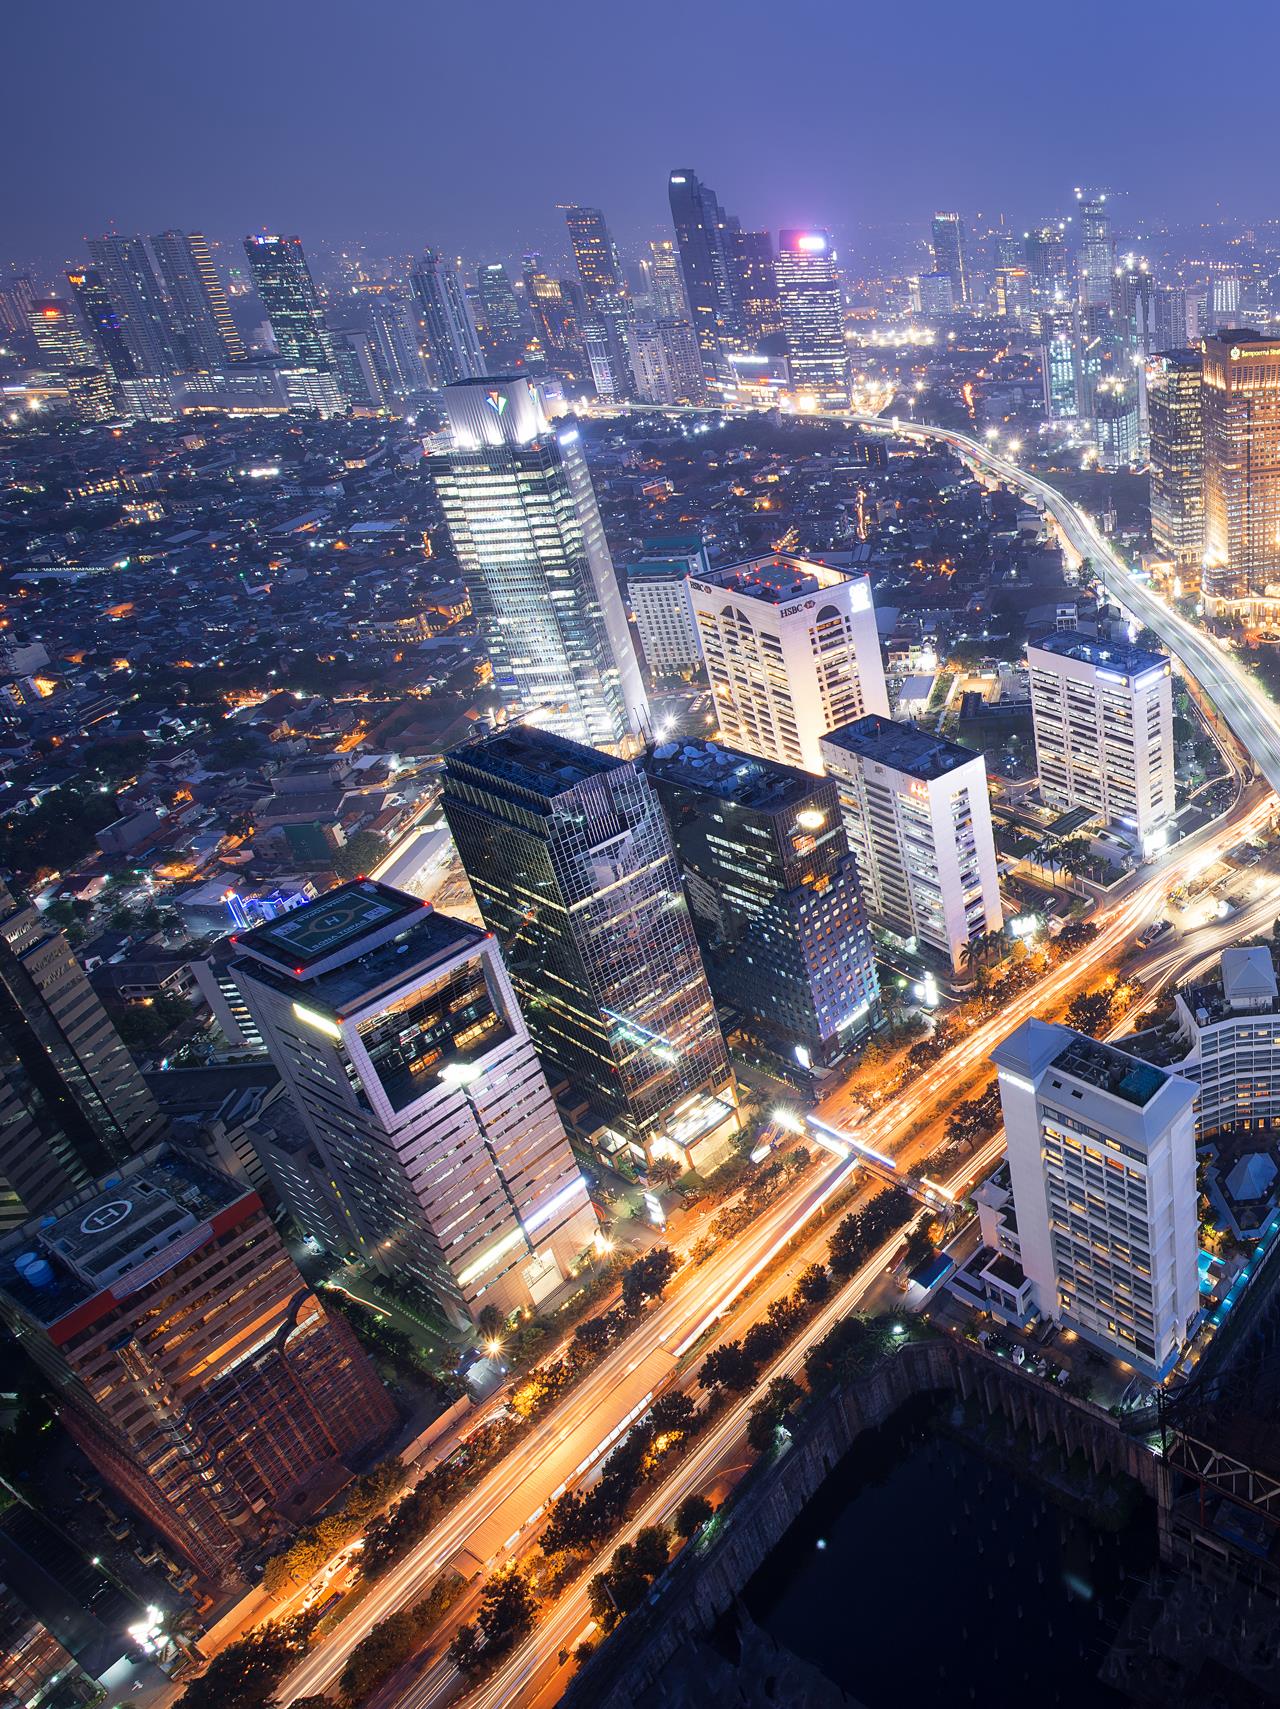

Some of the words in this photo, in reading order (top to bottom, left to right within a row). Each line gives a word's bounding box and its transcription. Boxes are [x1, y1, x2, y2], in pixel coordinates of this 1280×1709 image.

[690, 581, 704, 592] HSBC
[780, 604, 803, 618] HSBC
[324, 915, 339, 926] H
[93, 1208, 119, 1225] H
